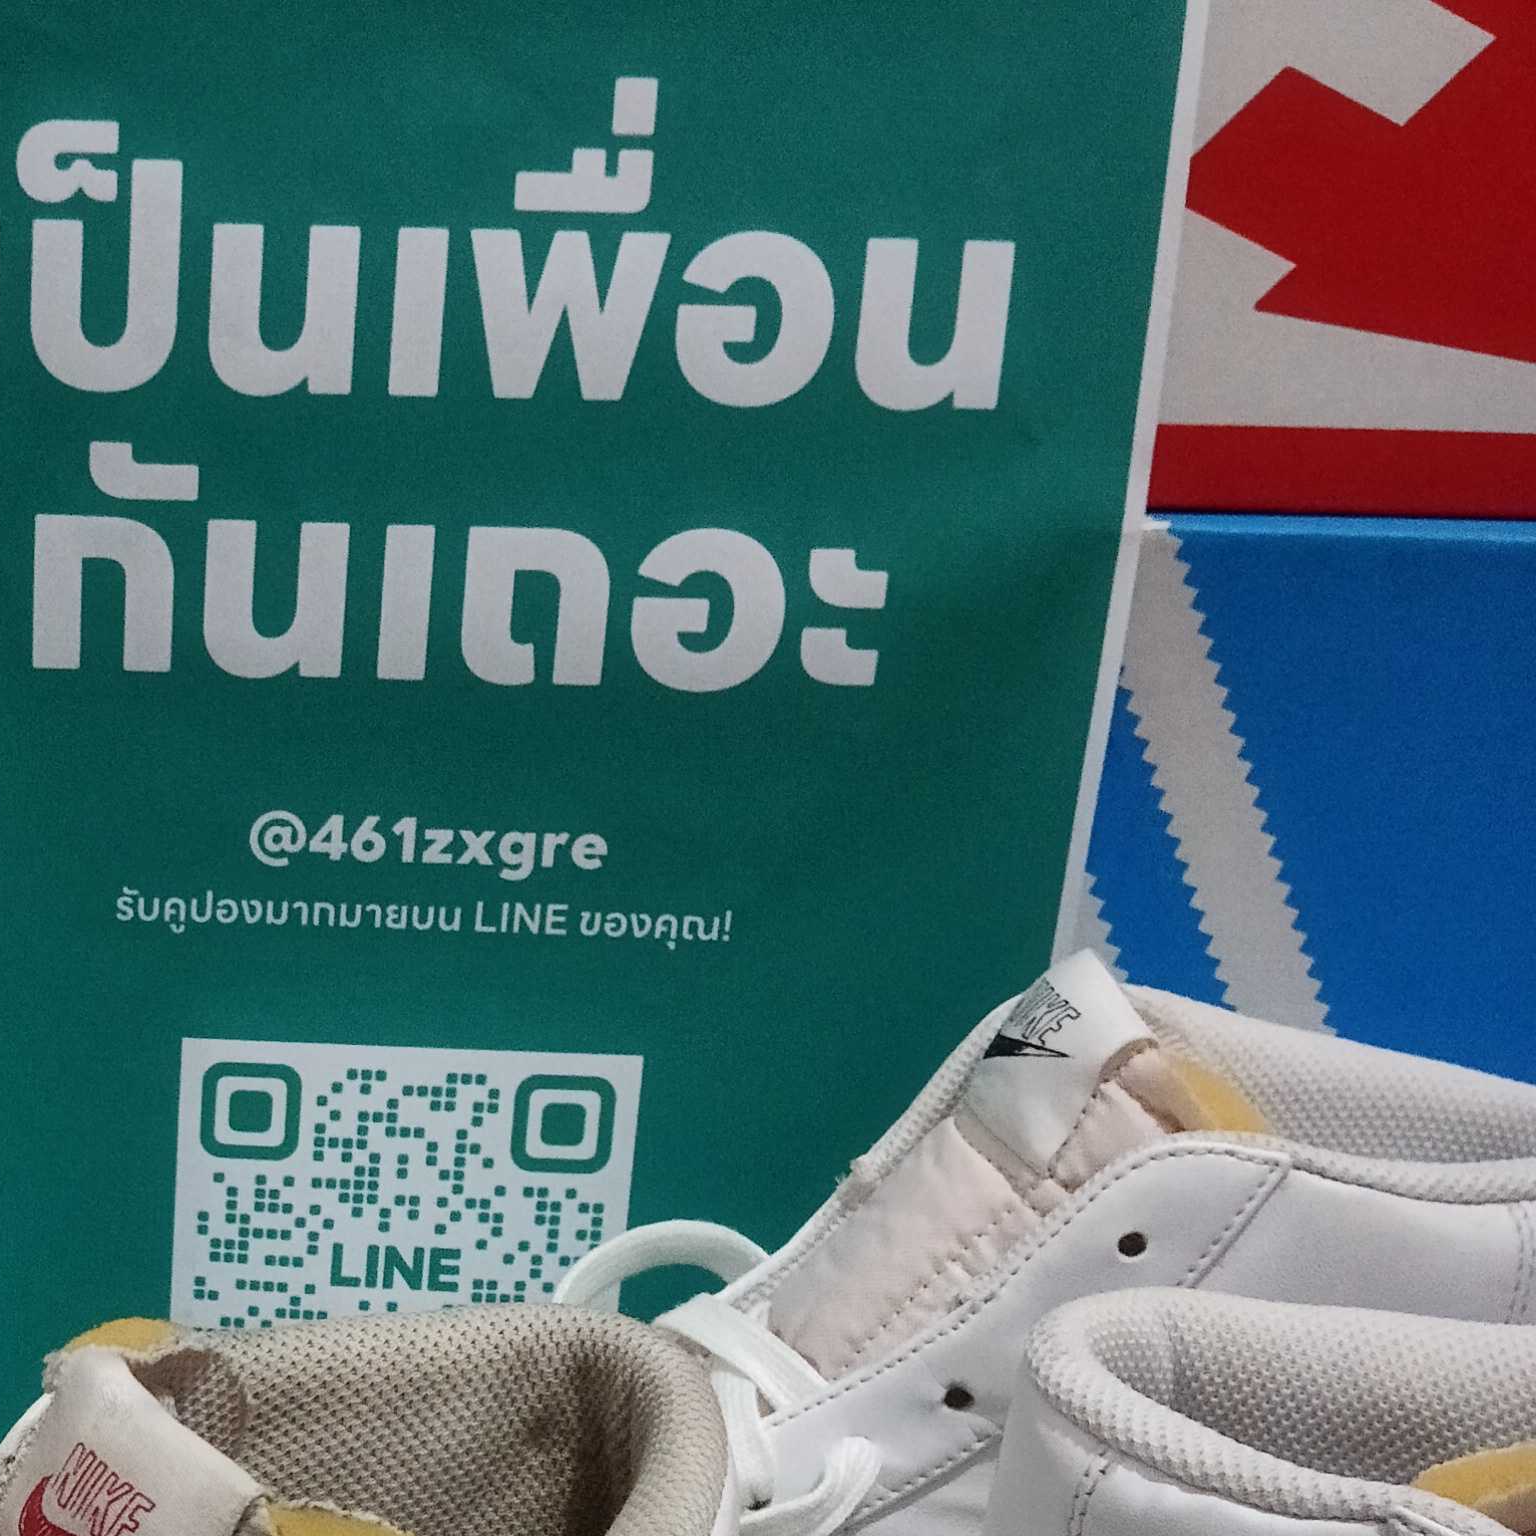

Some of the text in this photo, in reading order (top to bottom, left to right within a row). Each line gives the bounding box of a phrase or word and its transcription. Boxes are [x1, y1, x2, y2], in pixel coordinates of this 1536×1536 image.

[32, 441, 889, 693] กันเถอะ
[249, 810, 608, 881] @461zxgre
[116, 887, 732, 950] รับคูปองมากมายบน LINE ของคุณ!
[329, 1242, 462, 1293] LINE
